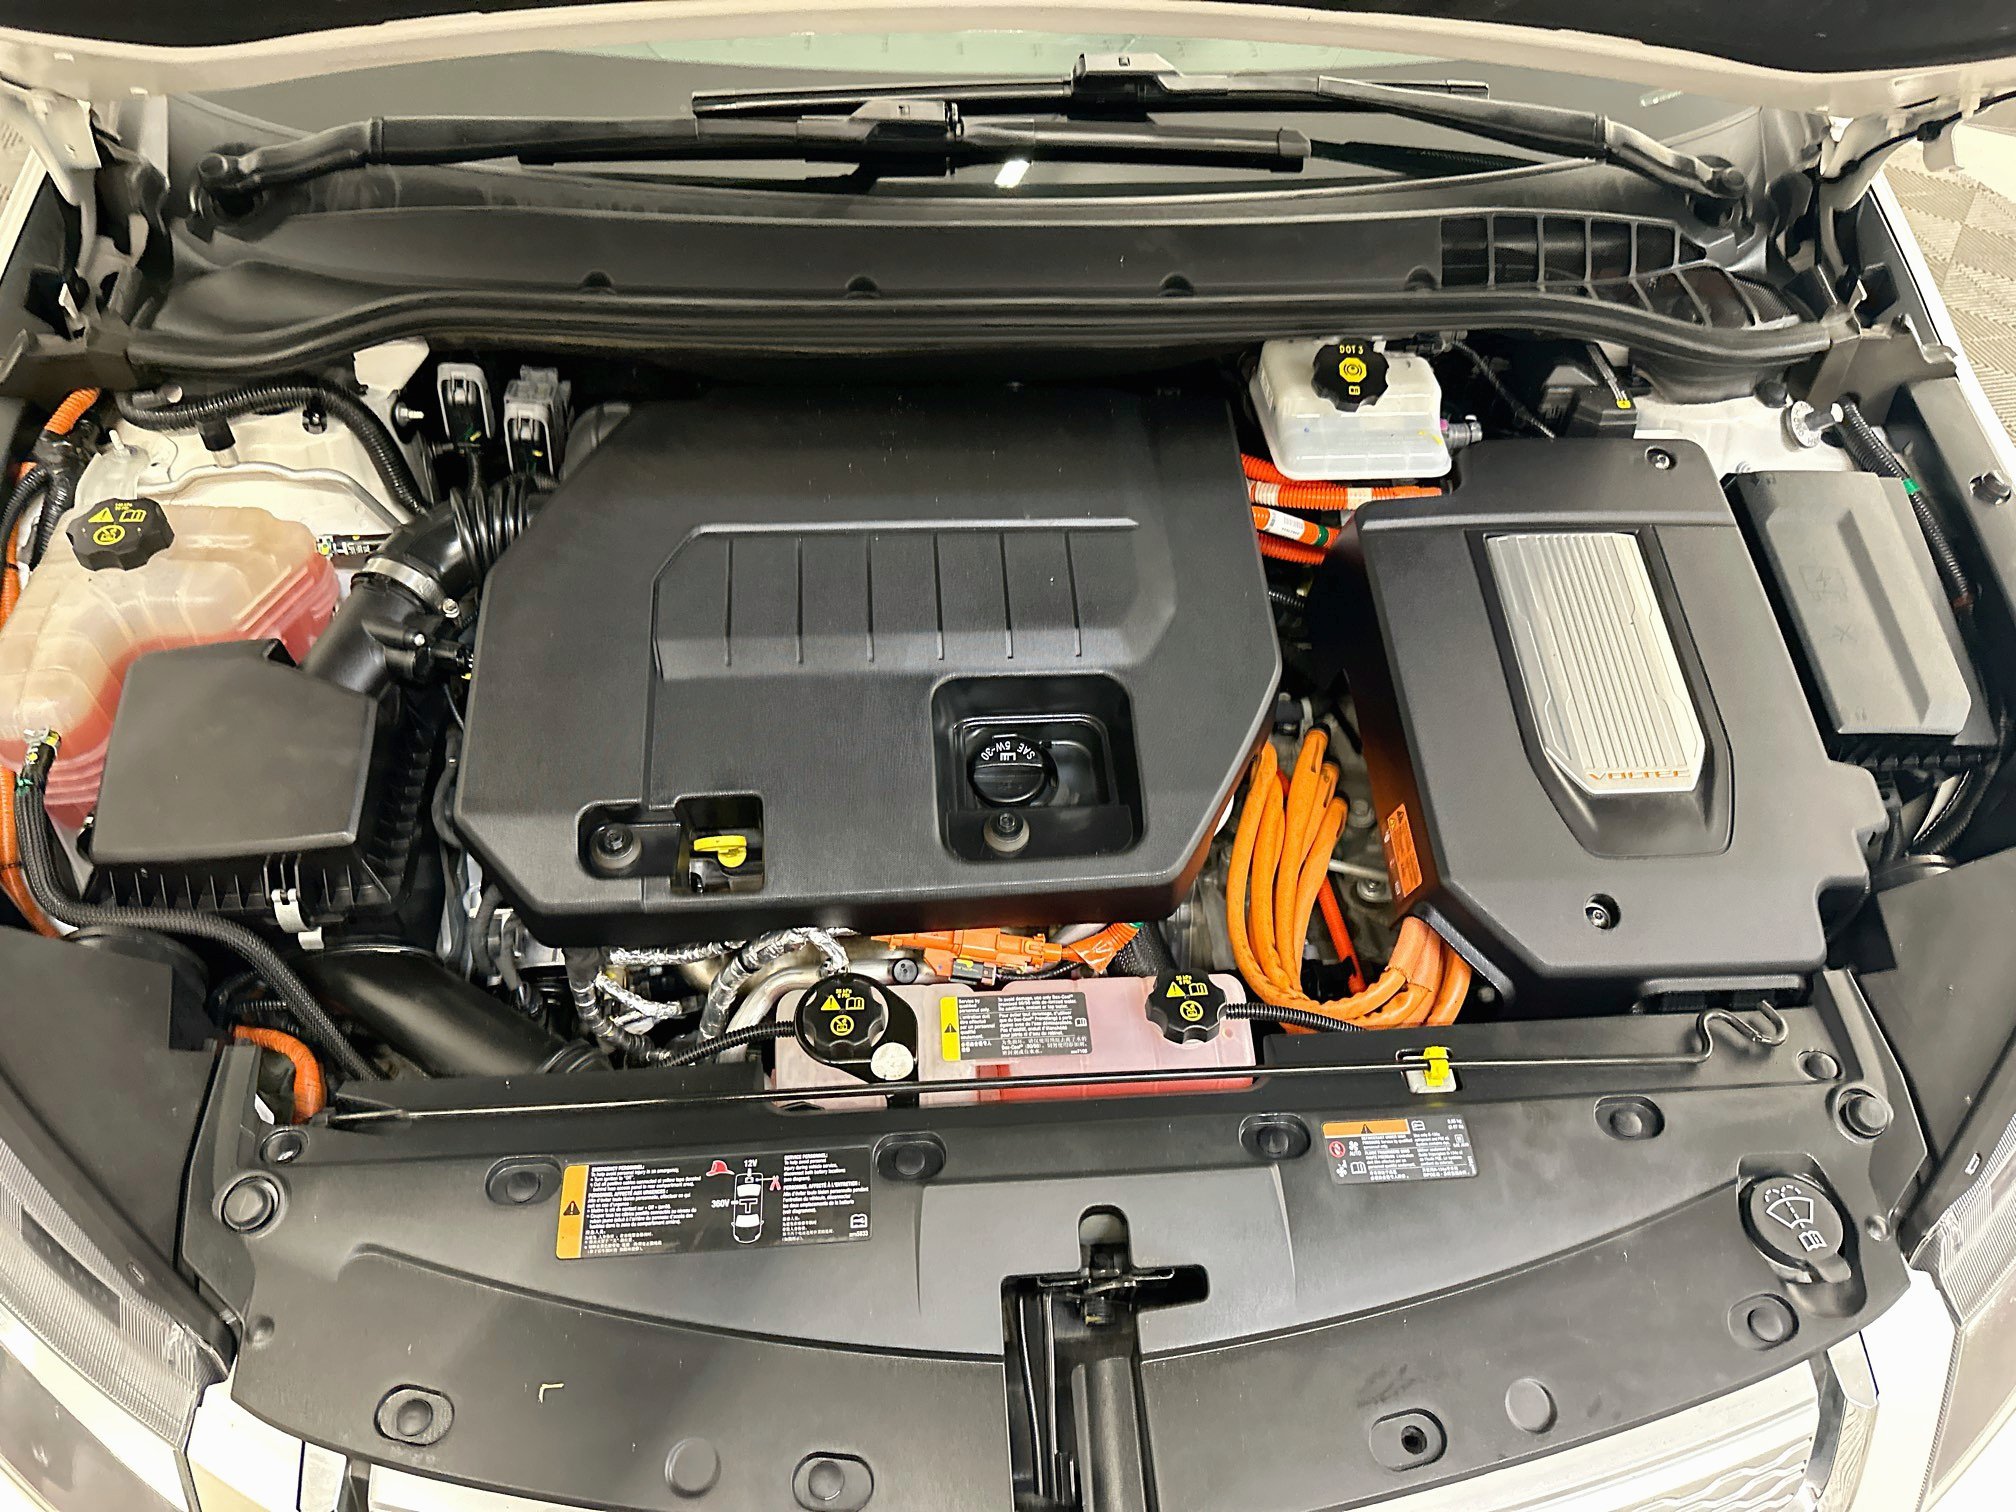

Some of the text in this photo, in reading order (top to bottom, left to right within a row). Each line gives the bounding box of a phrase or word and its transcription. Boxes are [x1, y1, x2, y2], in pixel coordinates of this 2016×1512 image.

[1339, 345, 1364, 354] DOT 3
[980, 740, 1036, 761] SAE 5W-30
[744, 1159, 758, 1168] 12V
[711, 1199, 730, 1208] 360V
